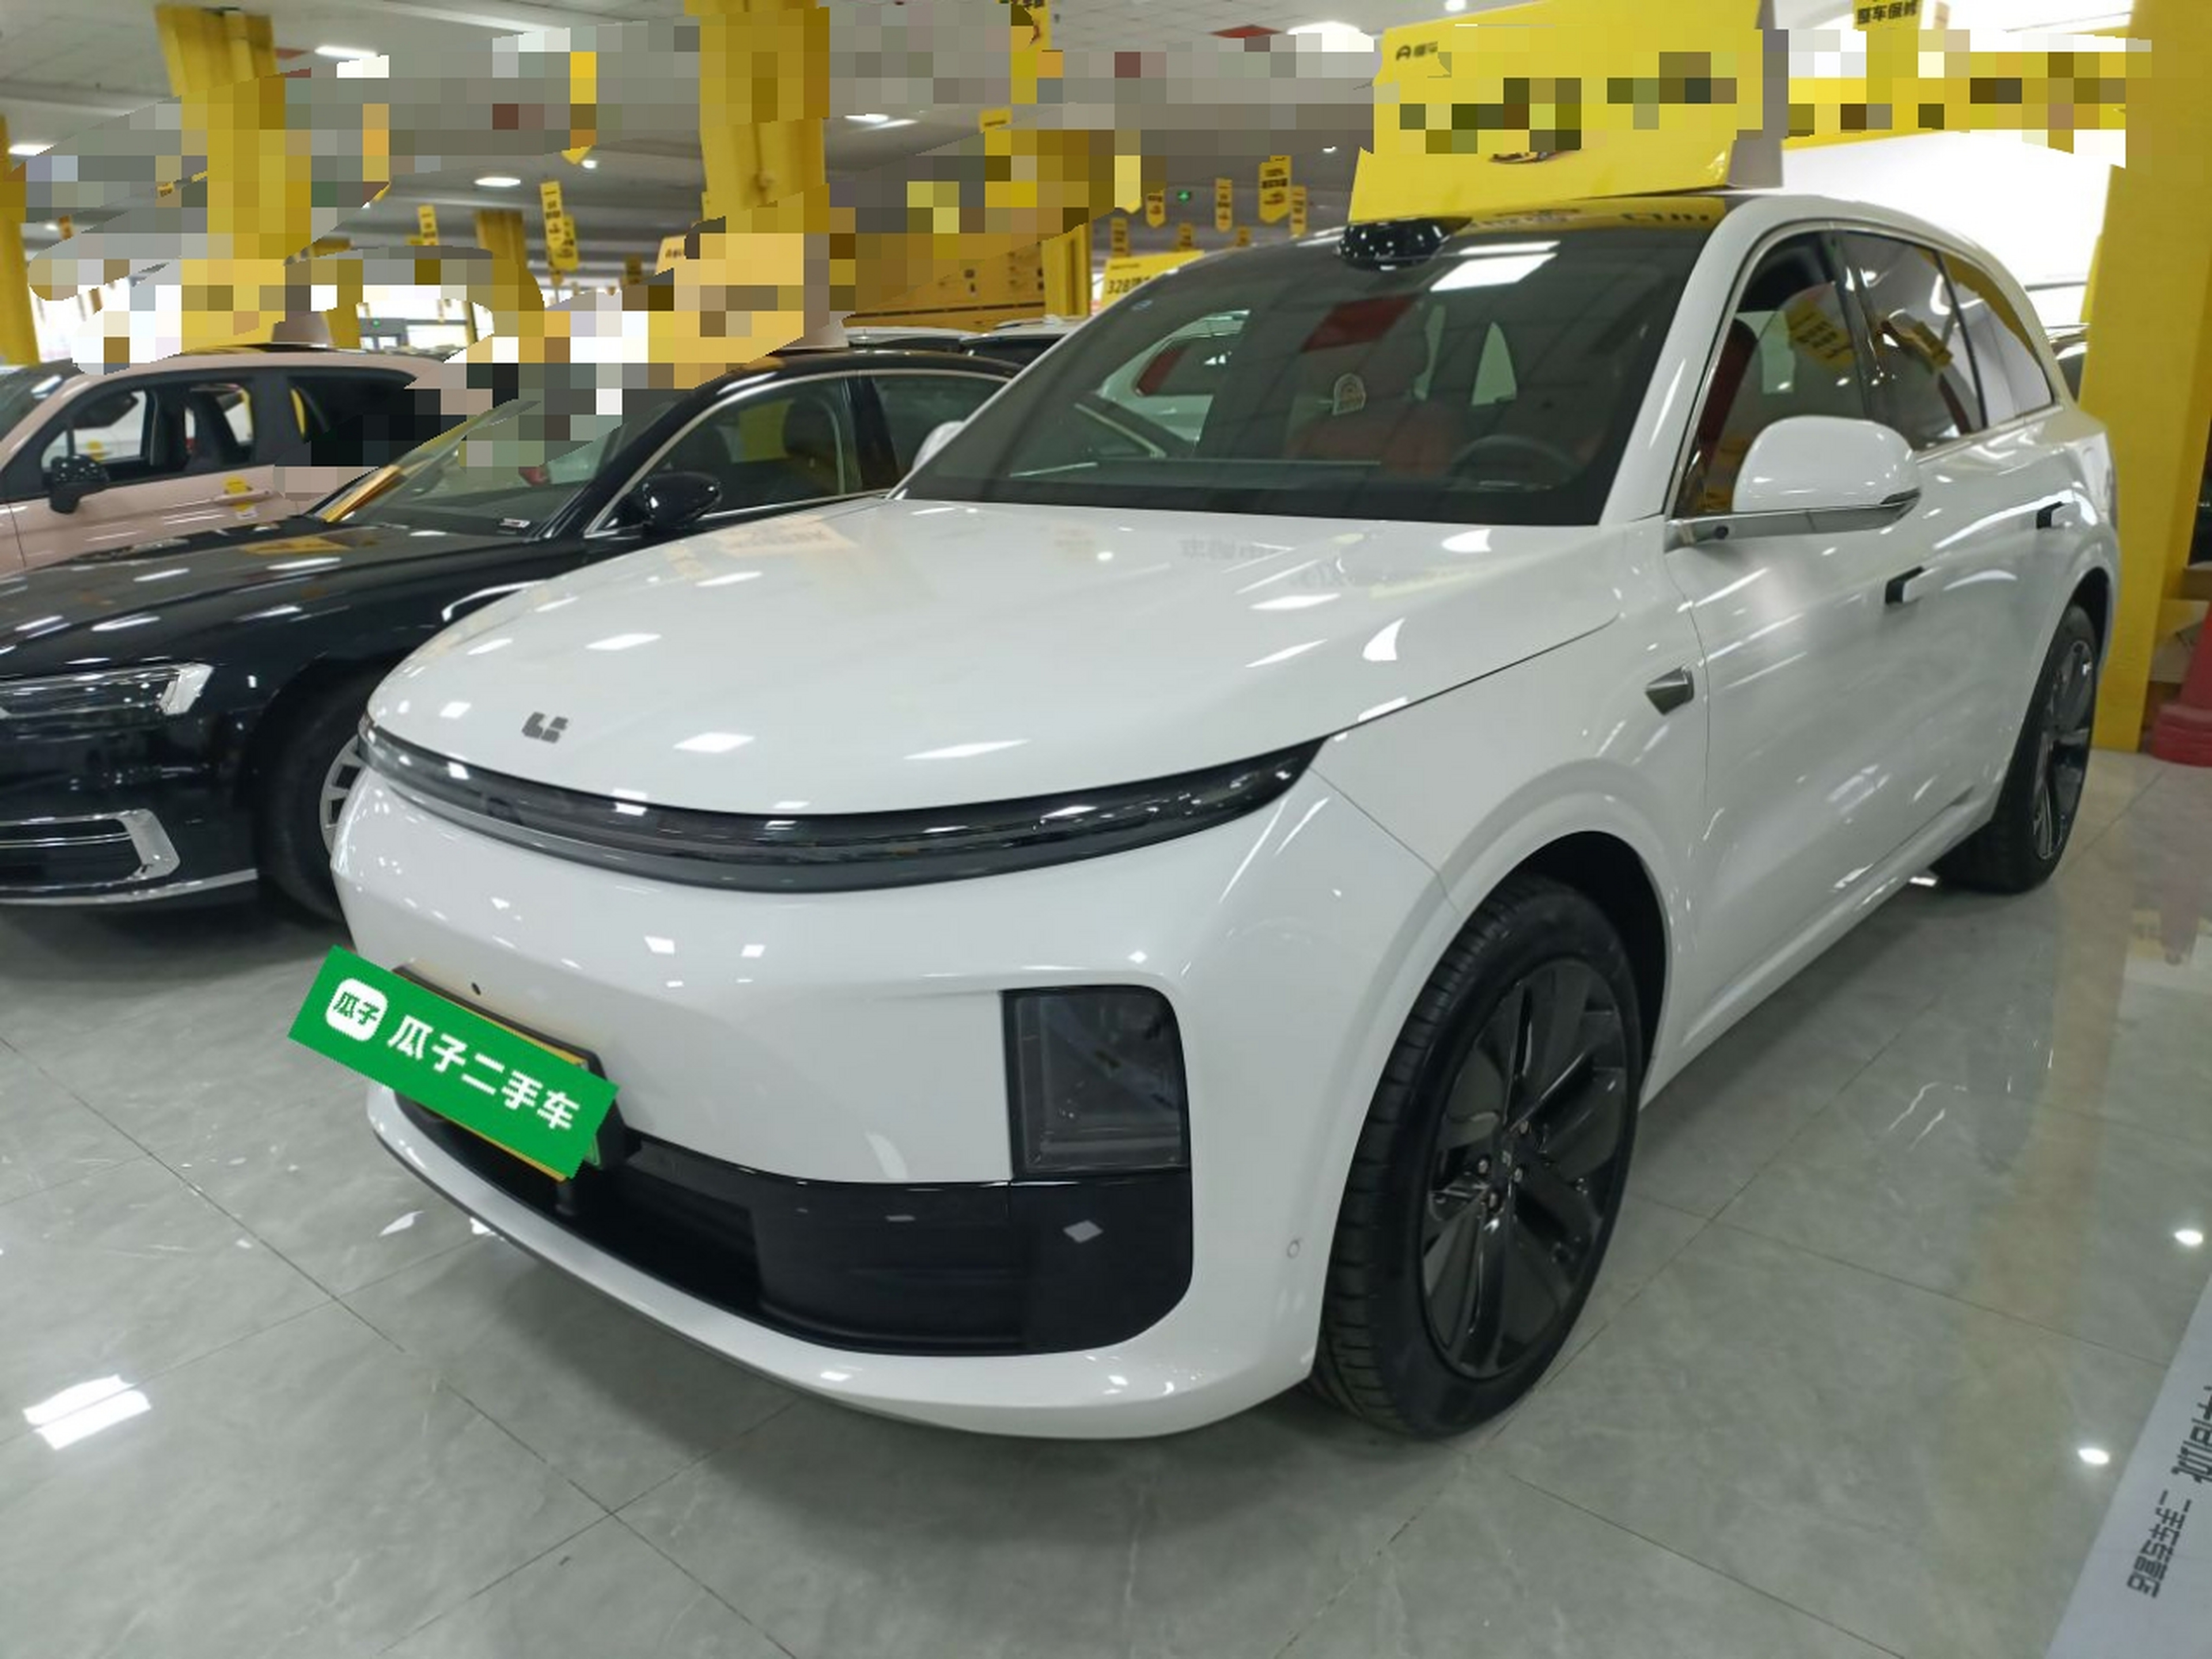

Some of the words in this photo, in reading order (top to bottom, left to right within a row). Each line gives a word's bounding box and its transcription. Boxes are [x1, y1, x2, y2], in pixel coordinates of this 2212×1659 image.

[2126, 1490, 2192, 1599] 二手车专营店
